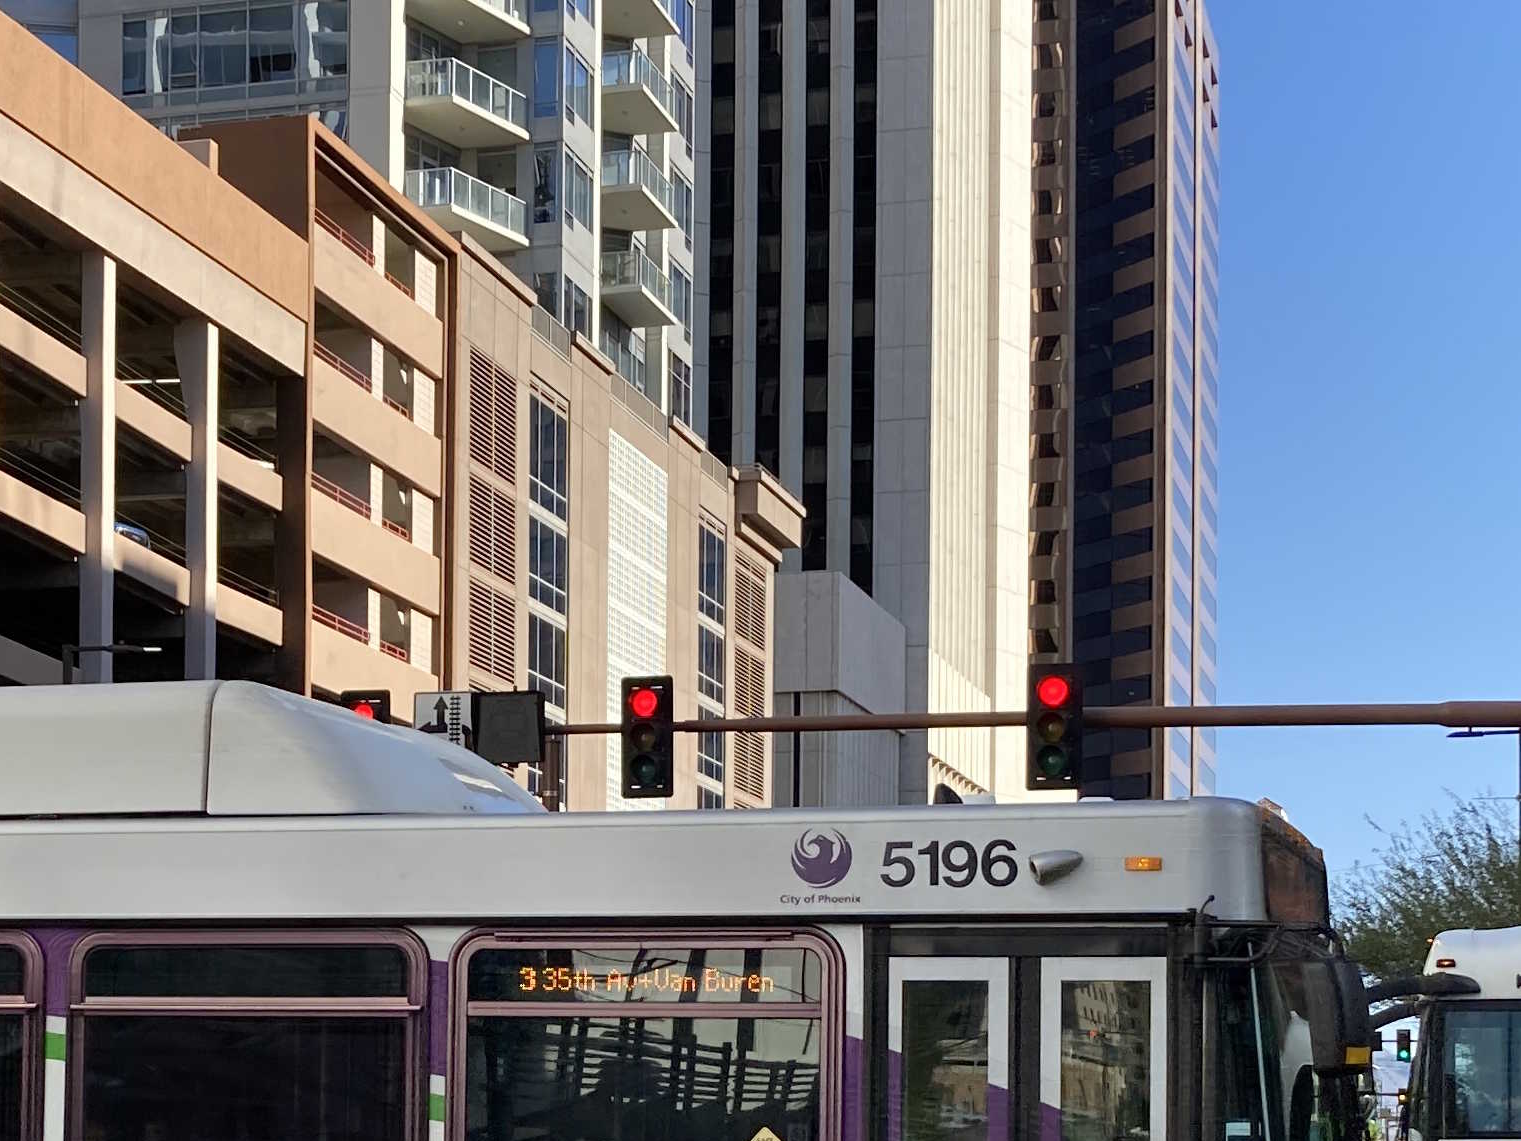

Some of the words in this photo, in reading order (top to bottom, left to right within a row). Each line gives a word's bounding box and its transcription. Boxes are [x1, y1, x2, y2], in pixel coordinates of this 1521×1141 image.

[880, 839, 1018, 888] 5196
[780, 894, 801, 905] City
[804, 894, 816, 904] of
[818, 894, 861, 904] Phoenix
[519, 967, 537, 991] 3
[542, 967, 596, 992] 35th
[703, 967, 774, 993] Buren
